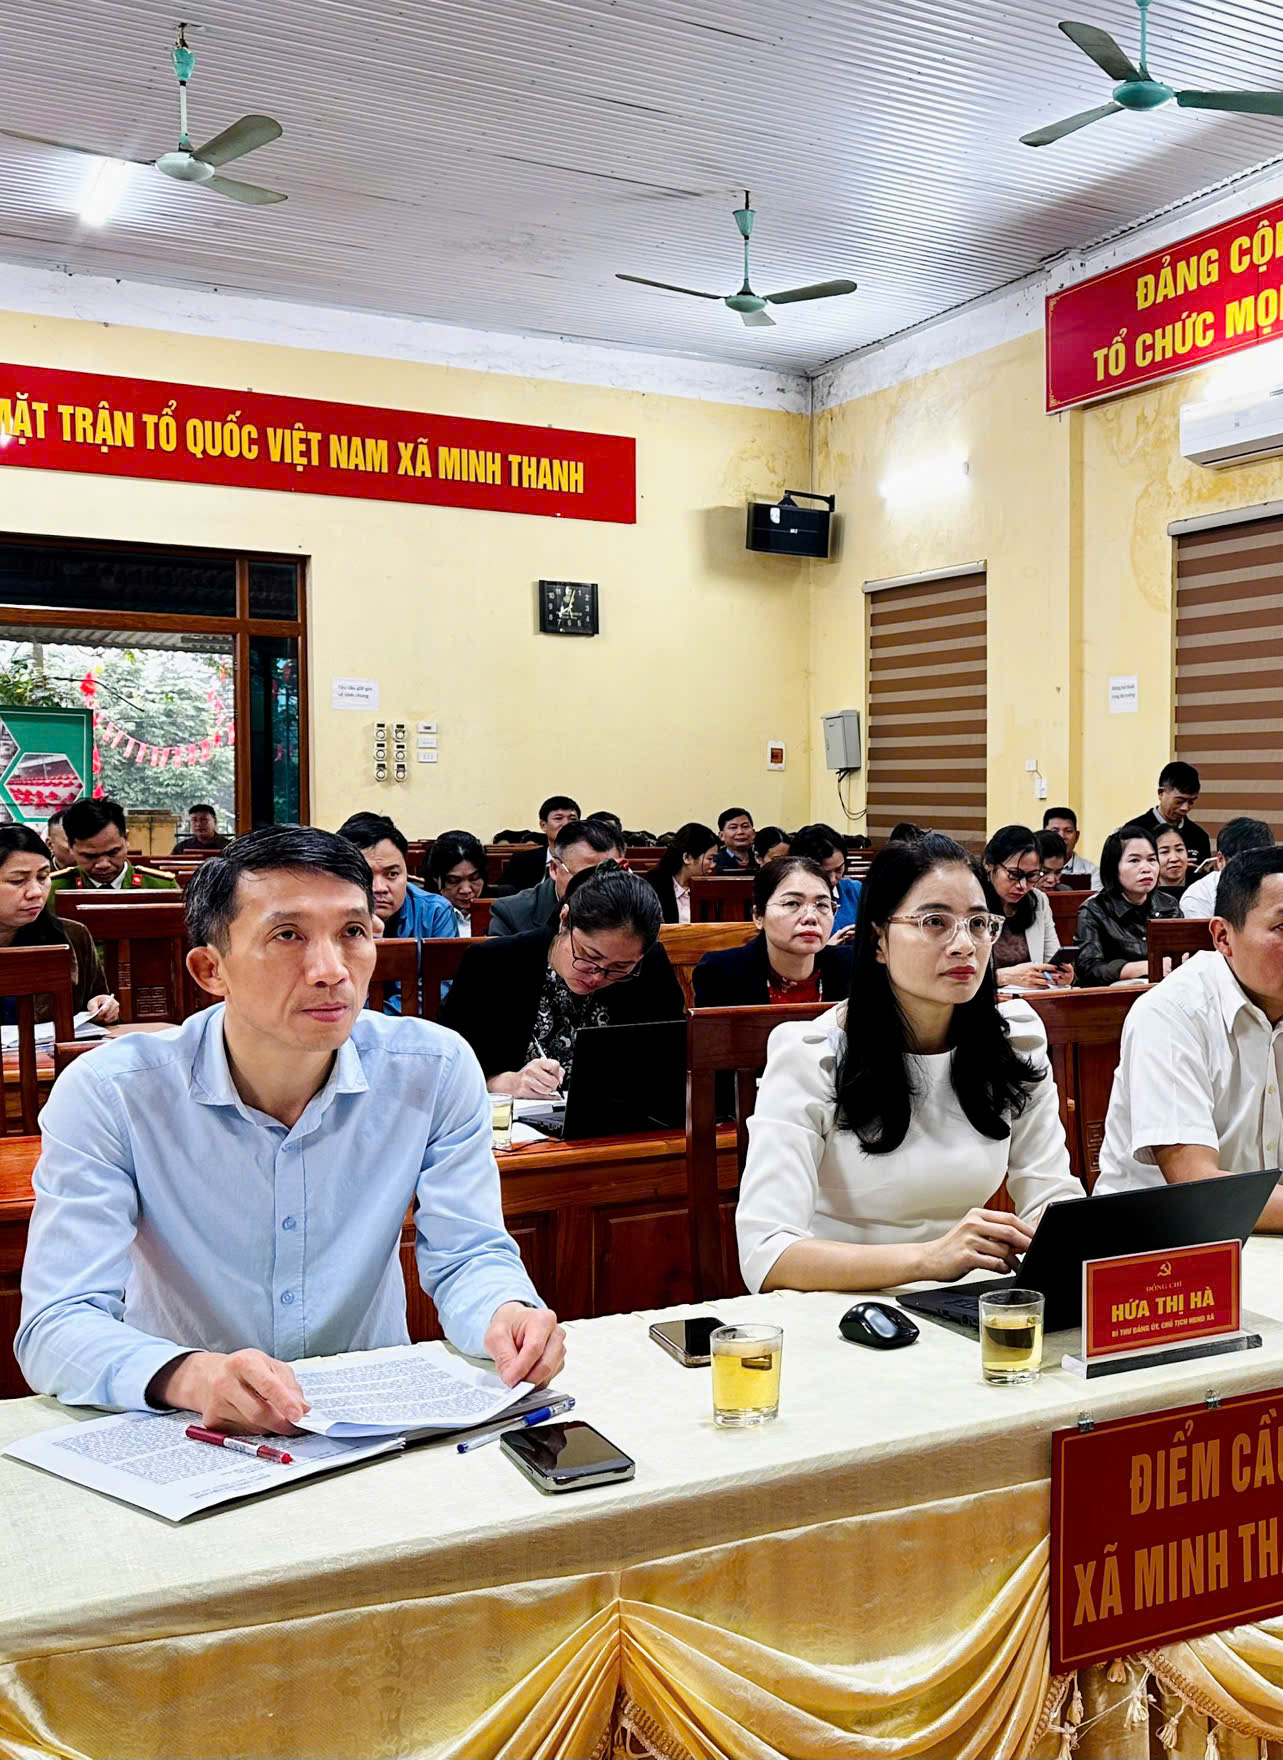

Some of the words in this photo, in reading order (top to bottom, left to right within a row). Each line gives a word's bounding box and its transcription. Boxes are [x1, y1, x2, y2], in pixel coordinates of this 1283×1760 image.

[1136, 249, 1219, 310] ĐẢNG
[1093, 326, 1127, 381] TỔ
[1135, 312, 1215, 367] CHỨC
[57, 400, 135, 453] TRẬN
[142, 400, 177, 452] TỔ
[185, 411, 259, 460] QUỐC
[266, 422, 322, 472] VIỆT
[329, 435, 389, 474] NAM
[399, 438, 432, 478] XÃ
[439, 447, 502, 485] MINH
[508, 455, 584, 494] THANH
[1112, 1298, 1150, 1322] HỨA
[1156, 1294, 1184, 1315] THỊ
[1190, 1286, 1216, 1309] HÀ
[1130, 1420, 1220, 1515] ĐIỂM
[1073, 1543, 1123, 1626] XÃ
[1135, 1530, 1229, 1610] MINH
